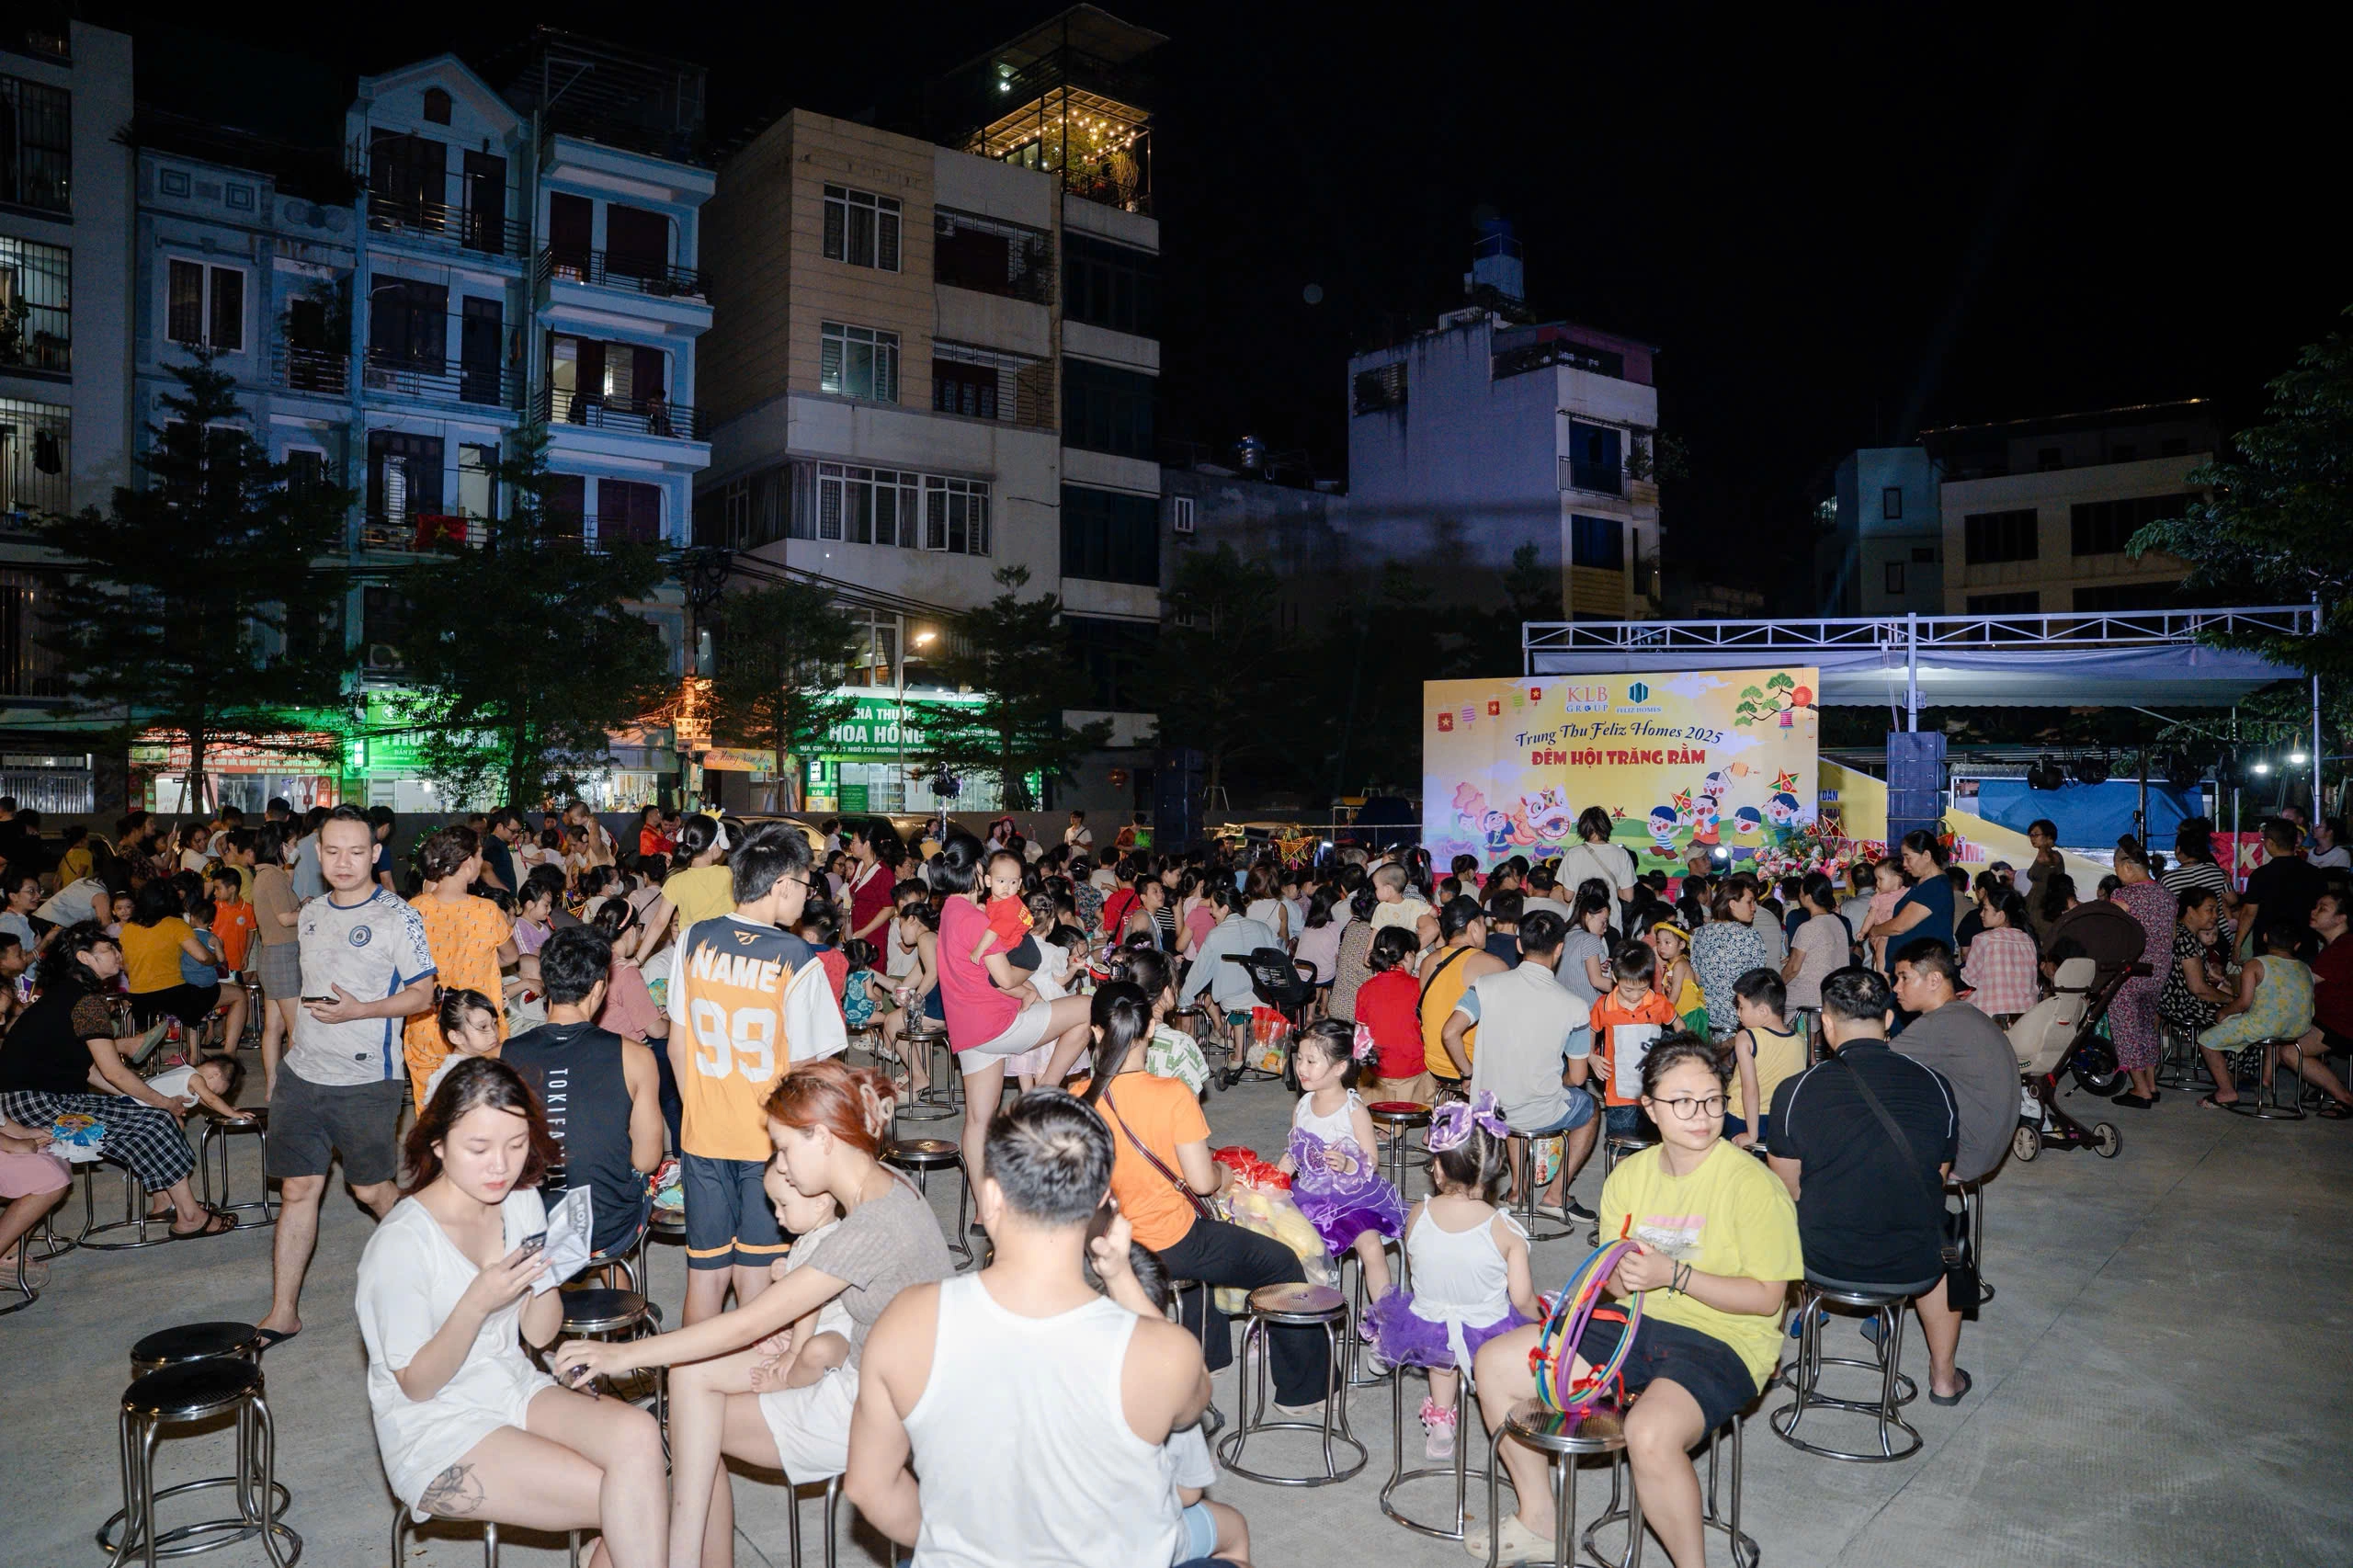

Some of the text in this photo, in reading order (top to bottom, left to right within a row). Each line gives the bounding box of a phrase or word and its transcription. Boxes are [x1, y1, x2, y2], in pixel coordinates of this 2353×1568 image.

[1567, 687, 1608, 702] KLB
[1566, 704, 1608, 712] GROUP
[829, 721, 926, 744] HOA HỒNG
[1515, 719, 1723, 746] Trung Thu Feliz Homes 2025
[1531, 743, 1706, 768] ĐÊM HỘI TRĂNG RẰM
[691, 948, 781, 994] NAME
[690, 997, 777, 1083] 99
[546, 1068, 568, 1192] TOKIFAILY
